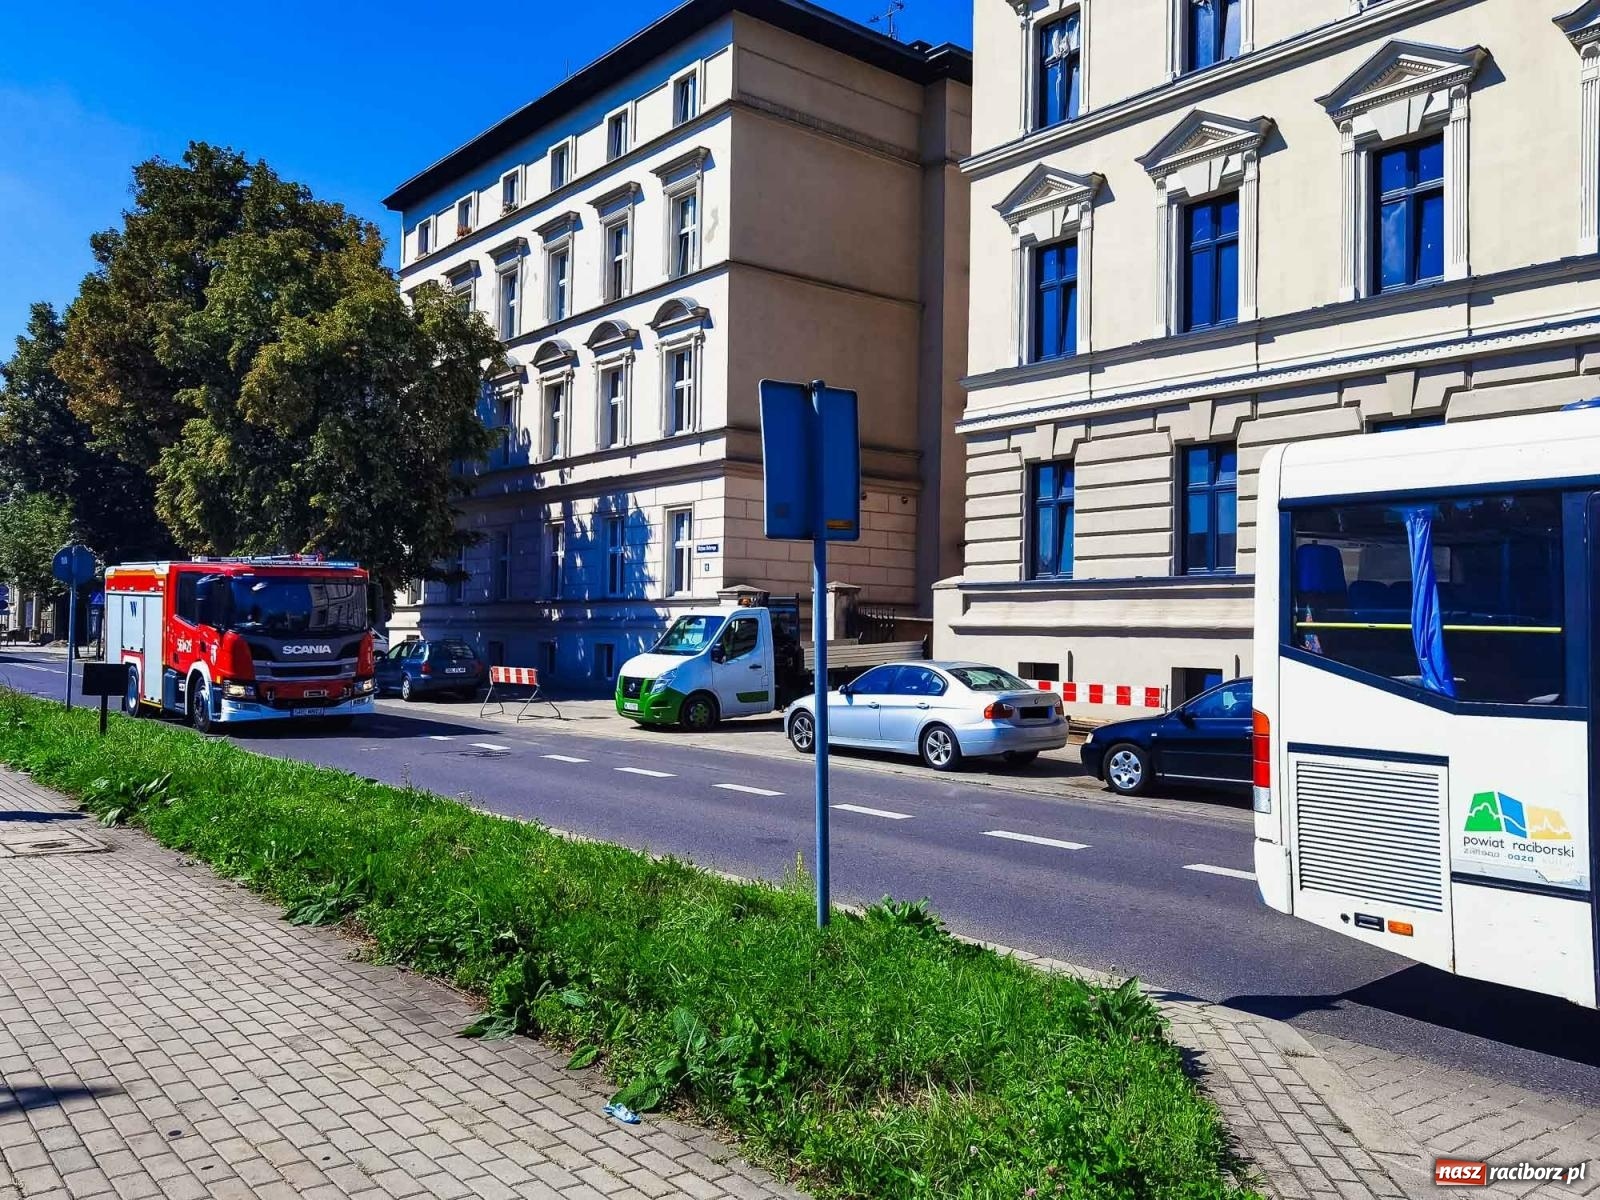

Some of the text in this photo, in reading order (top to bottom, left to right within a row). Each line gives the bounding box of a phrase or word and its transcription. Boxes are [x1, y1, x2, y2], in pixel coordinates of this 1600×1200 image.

[282, 645, 331, 654] SCANIA
[1463, 836, 1575, 858] powiat raciborski
[1507, 853, 1534, 862] oaza
